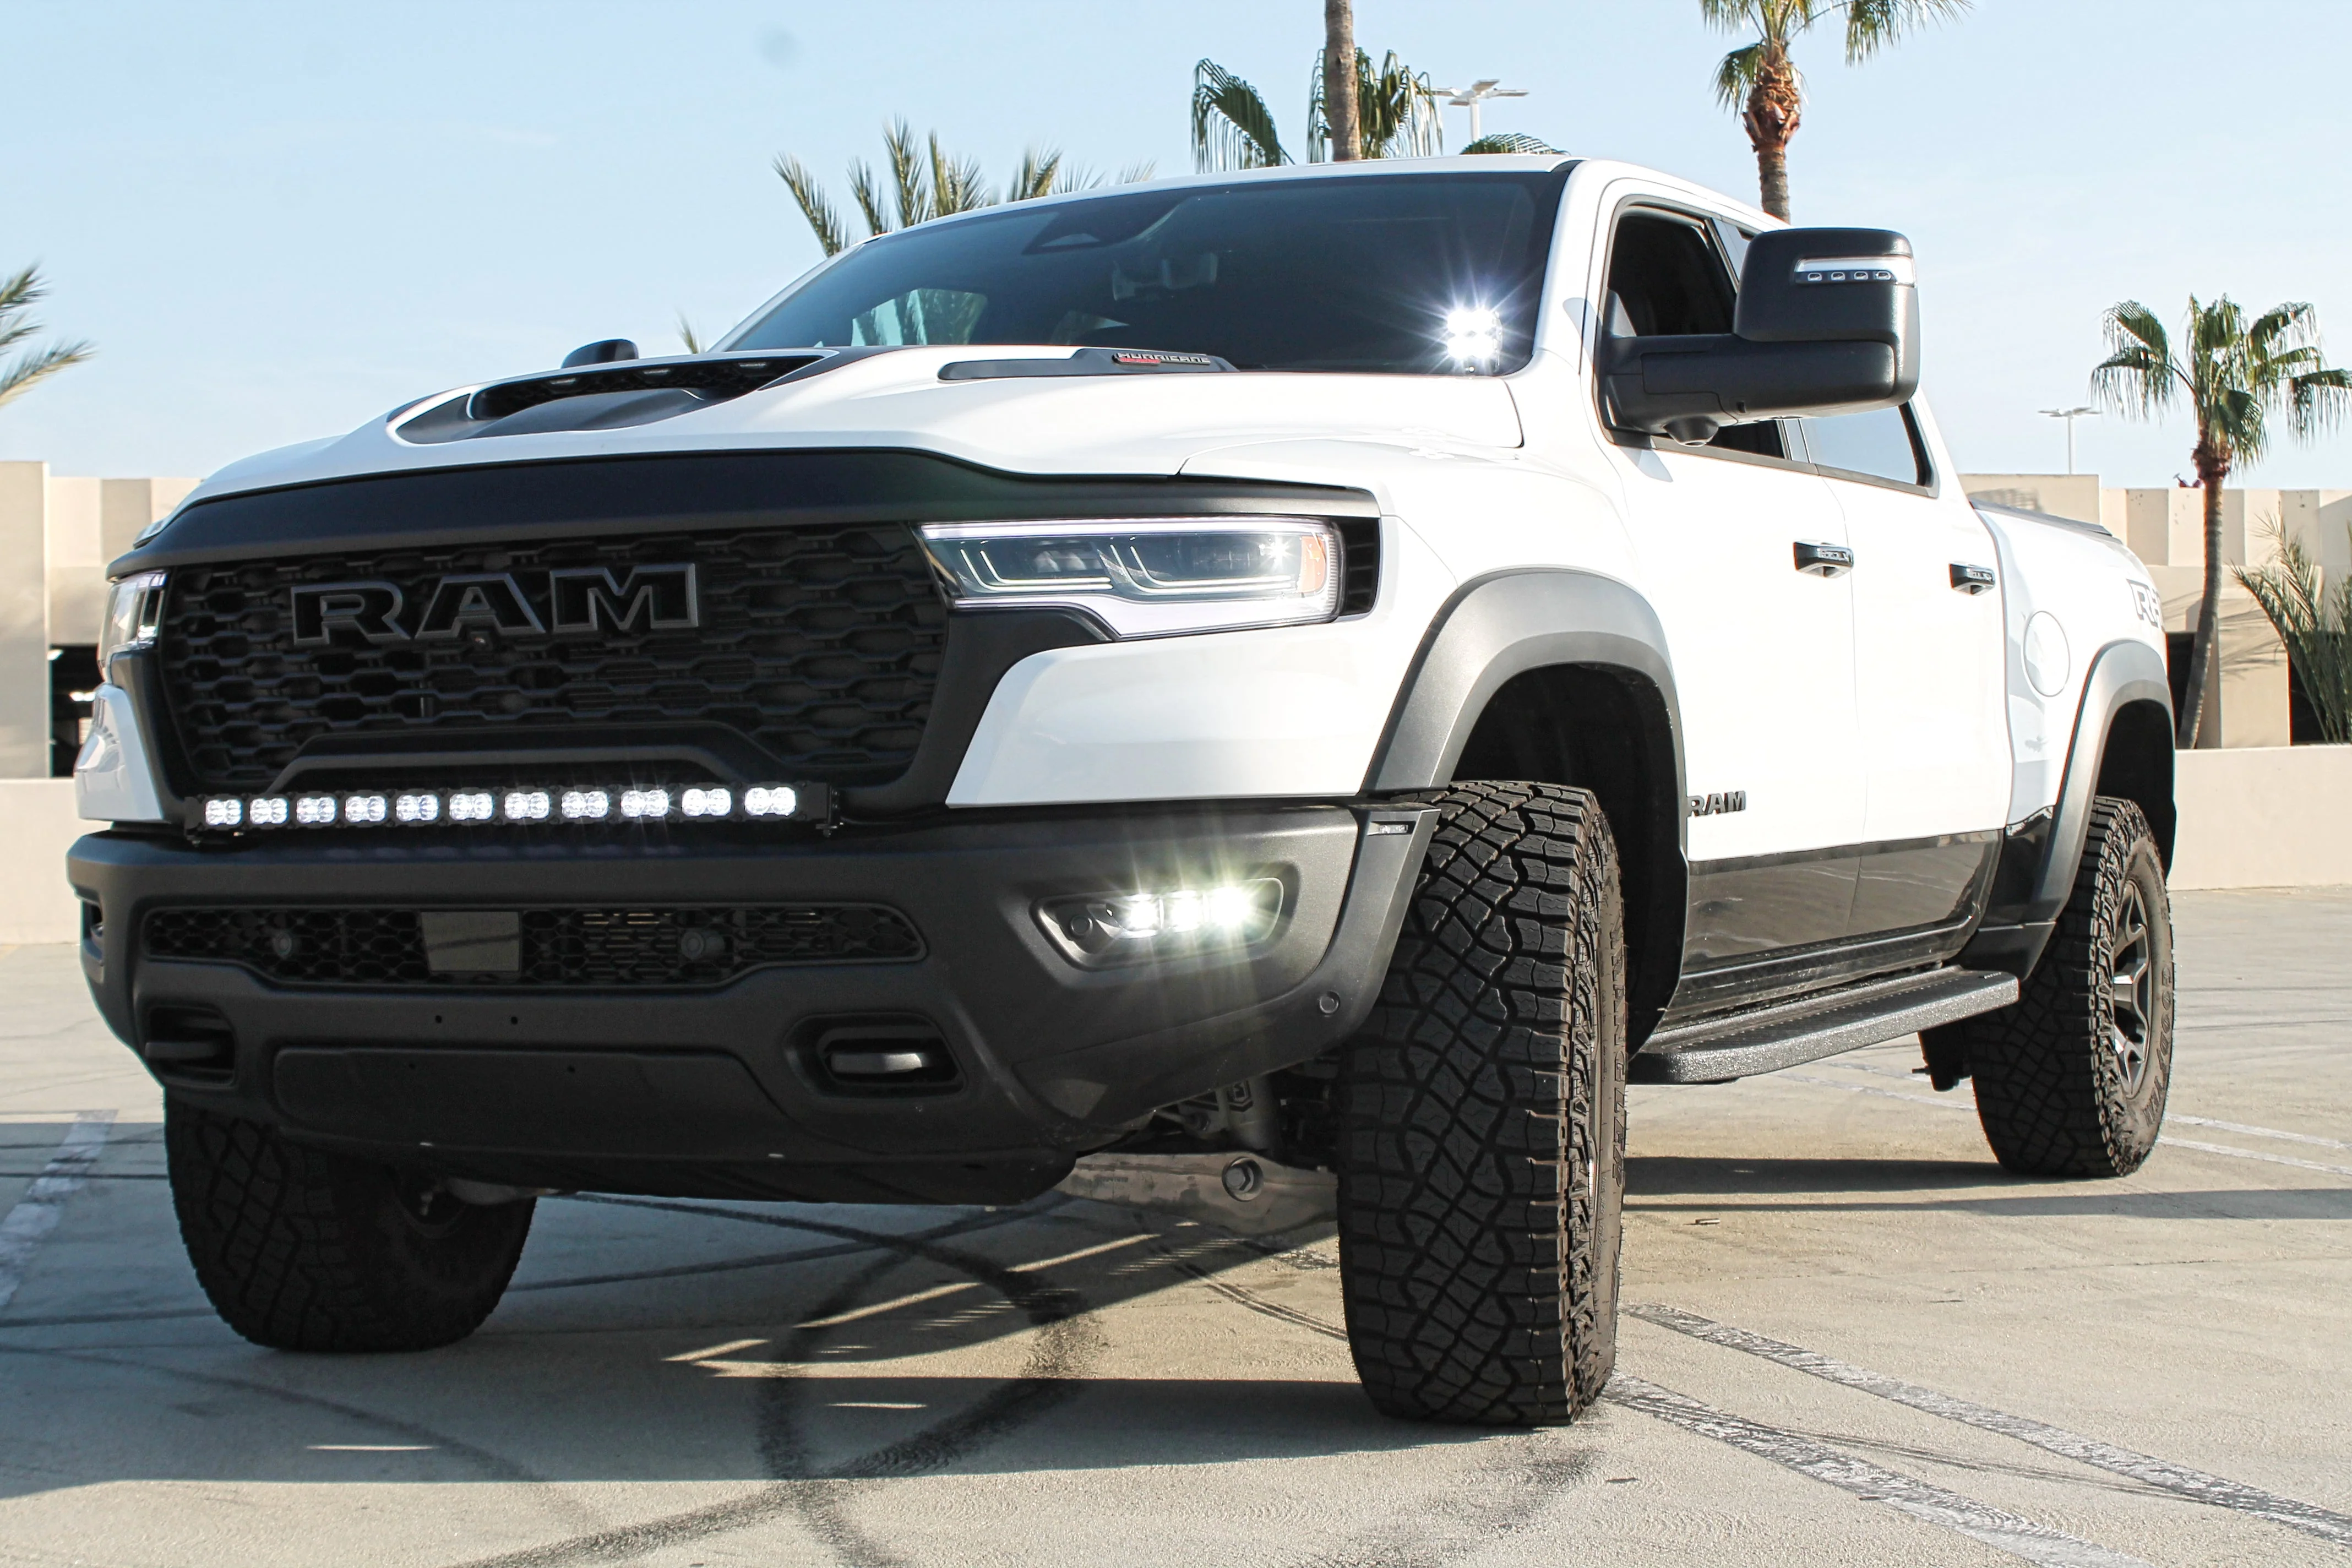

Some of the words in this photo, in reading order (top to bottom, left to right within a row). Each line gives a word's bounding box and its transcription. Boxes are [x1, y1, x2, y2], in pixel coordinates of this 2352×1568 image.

[1117, 352, 1211, 364] HURRICANE
[290, 563, 699, 646] RAM
[1687, 790, 1746, 817] RAM
[1610, 911, 1626, 1188] WRANGLER
